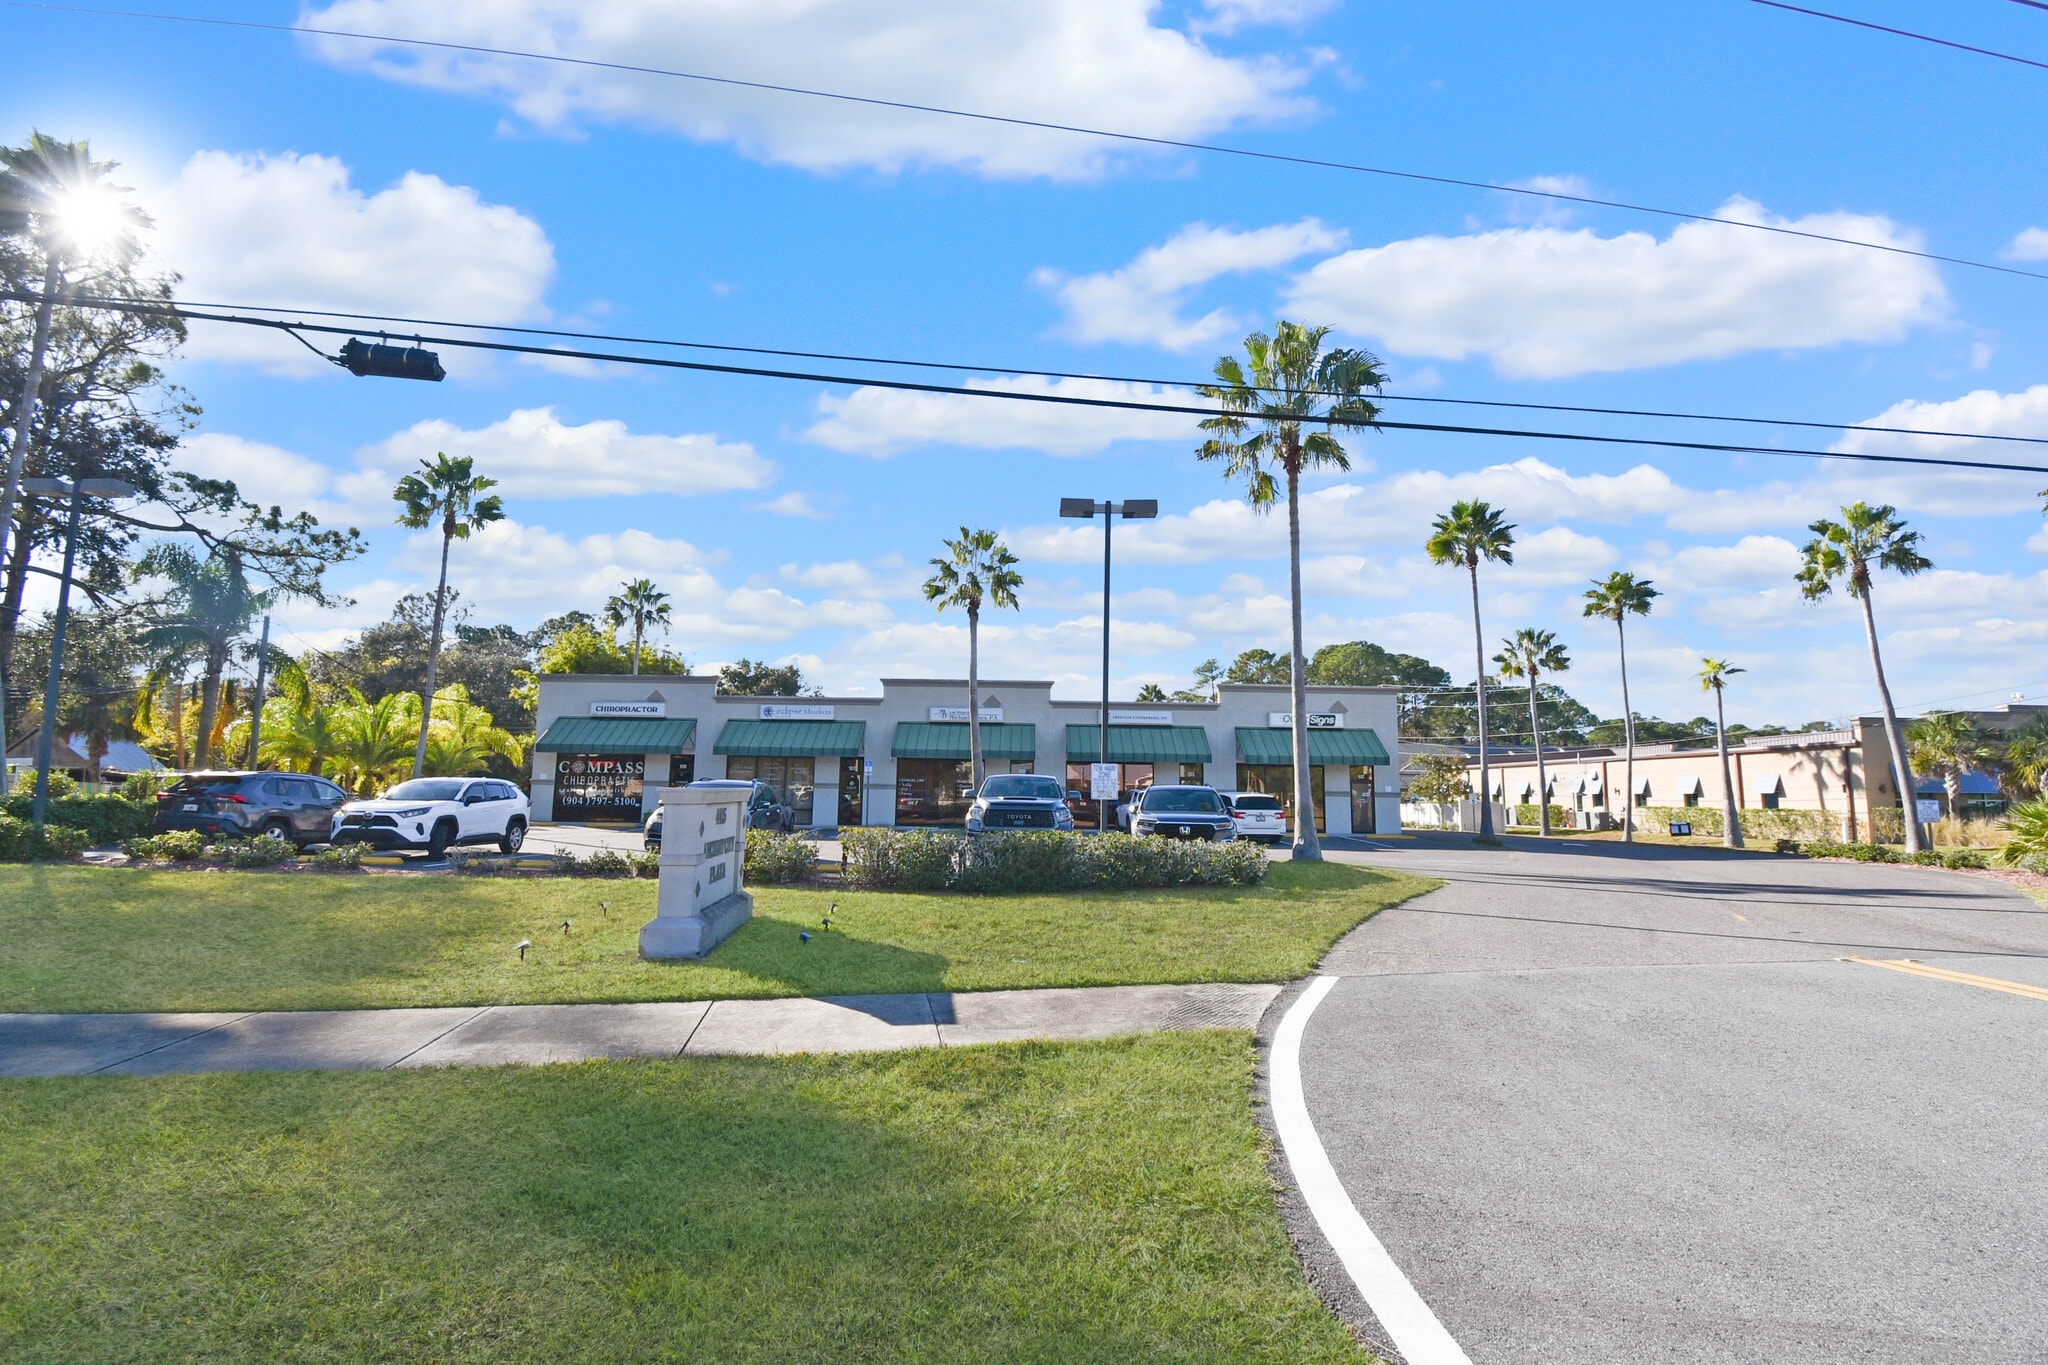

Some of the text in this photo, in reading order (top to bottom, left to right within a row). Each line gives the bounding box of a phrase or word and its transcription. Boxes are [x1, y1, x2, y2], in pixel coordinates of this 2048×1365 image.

[595, 705, 658, 713] CHIROPRACTOR
[777, 706, 832, 718] eclipse studios
[1310, 715, 1335, 726] Signs
[709, 862, 726, 884] PLAZA
